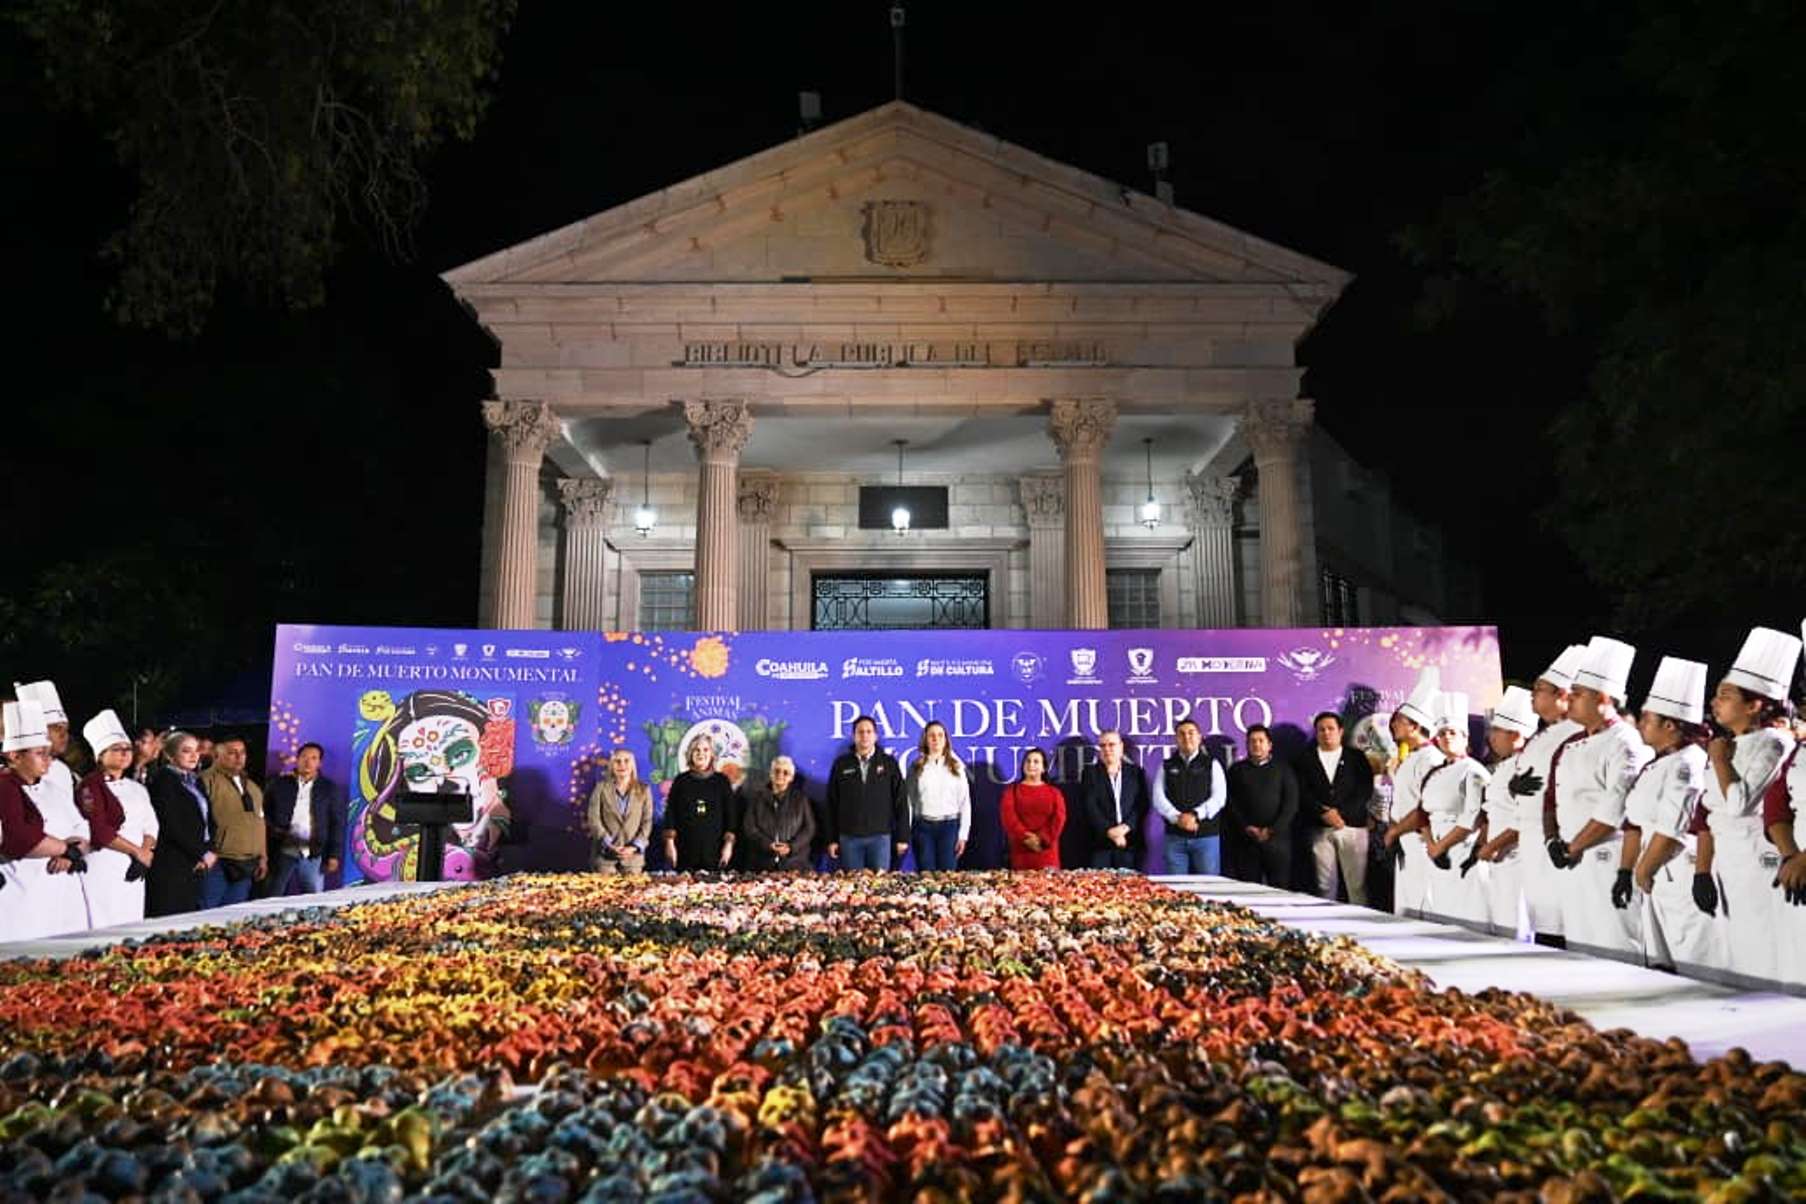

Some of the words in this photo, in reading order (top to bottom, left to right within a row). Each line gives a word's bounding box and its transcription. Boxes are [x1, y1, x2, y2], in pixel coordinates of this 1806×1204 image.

[296, 663, 333, 677] PAN
[338, 664, 362, 678] DE
[368, 664, 447, 680] MUERTO
[450, 665, 581, 683] MONUMENTAL
[755, 659, 829, 676] COAHUILA
[831, 700, 942, 739] PAN
[951, 699, 1026, 738] DE
[1038, 697, 1273, 738] MUERTO
